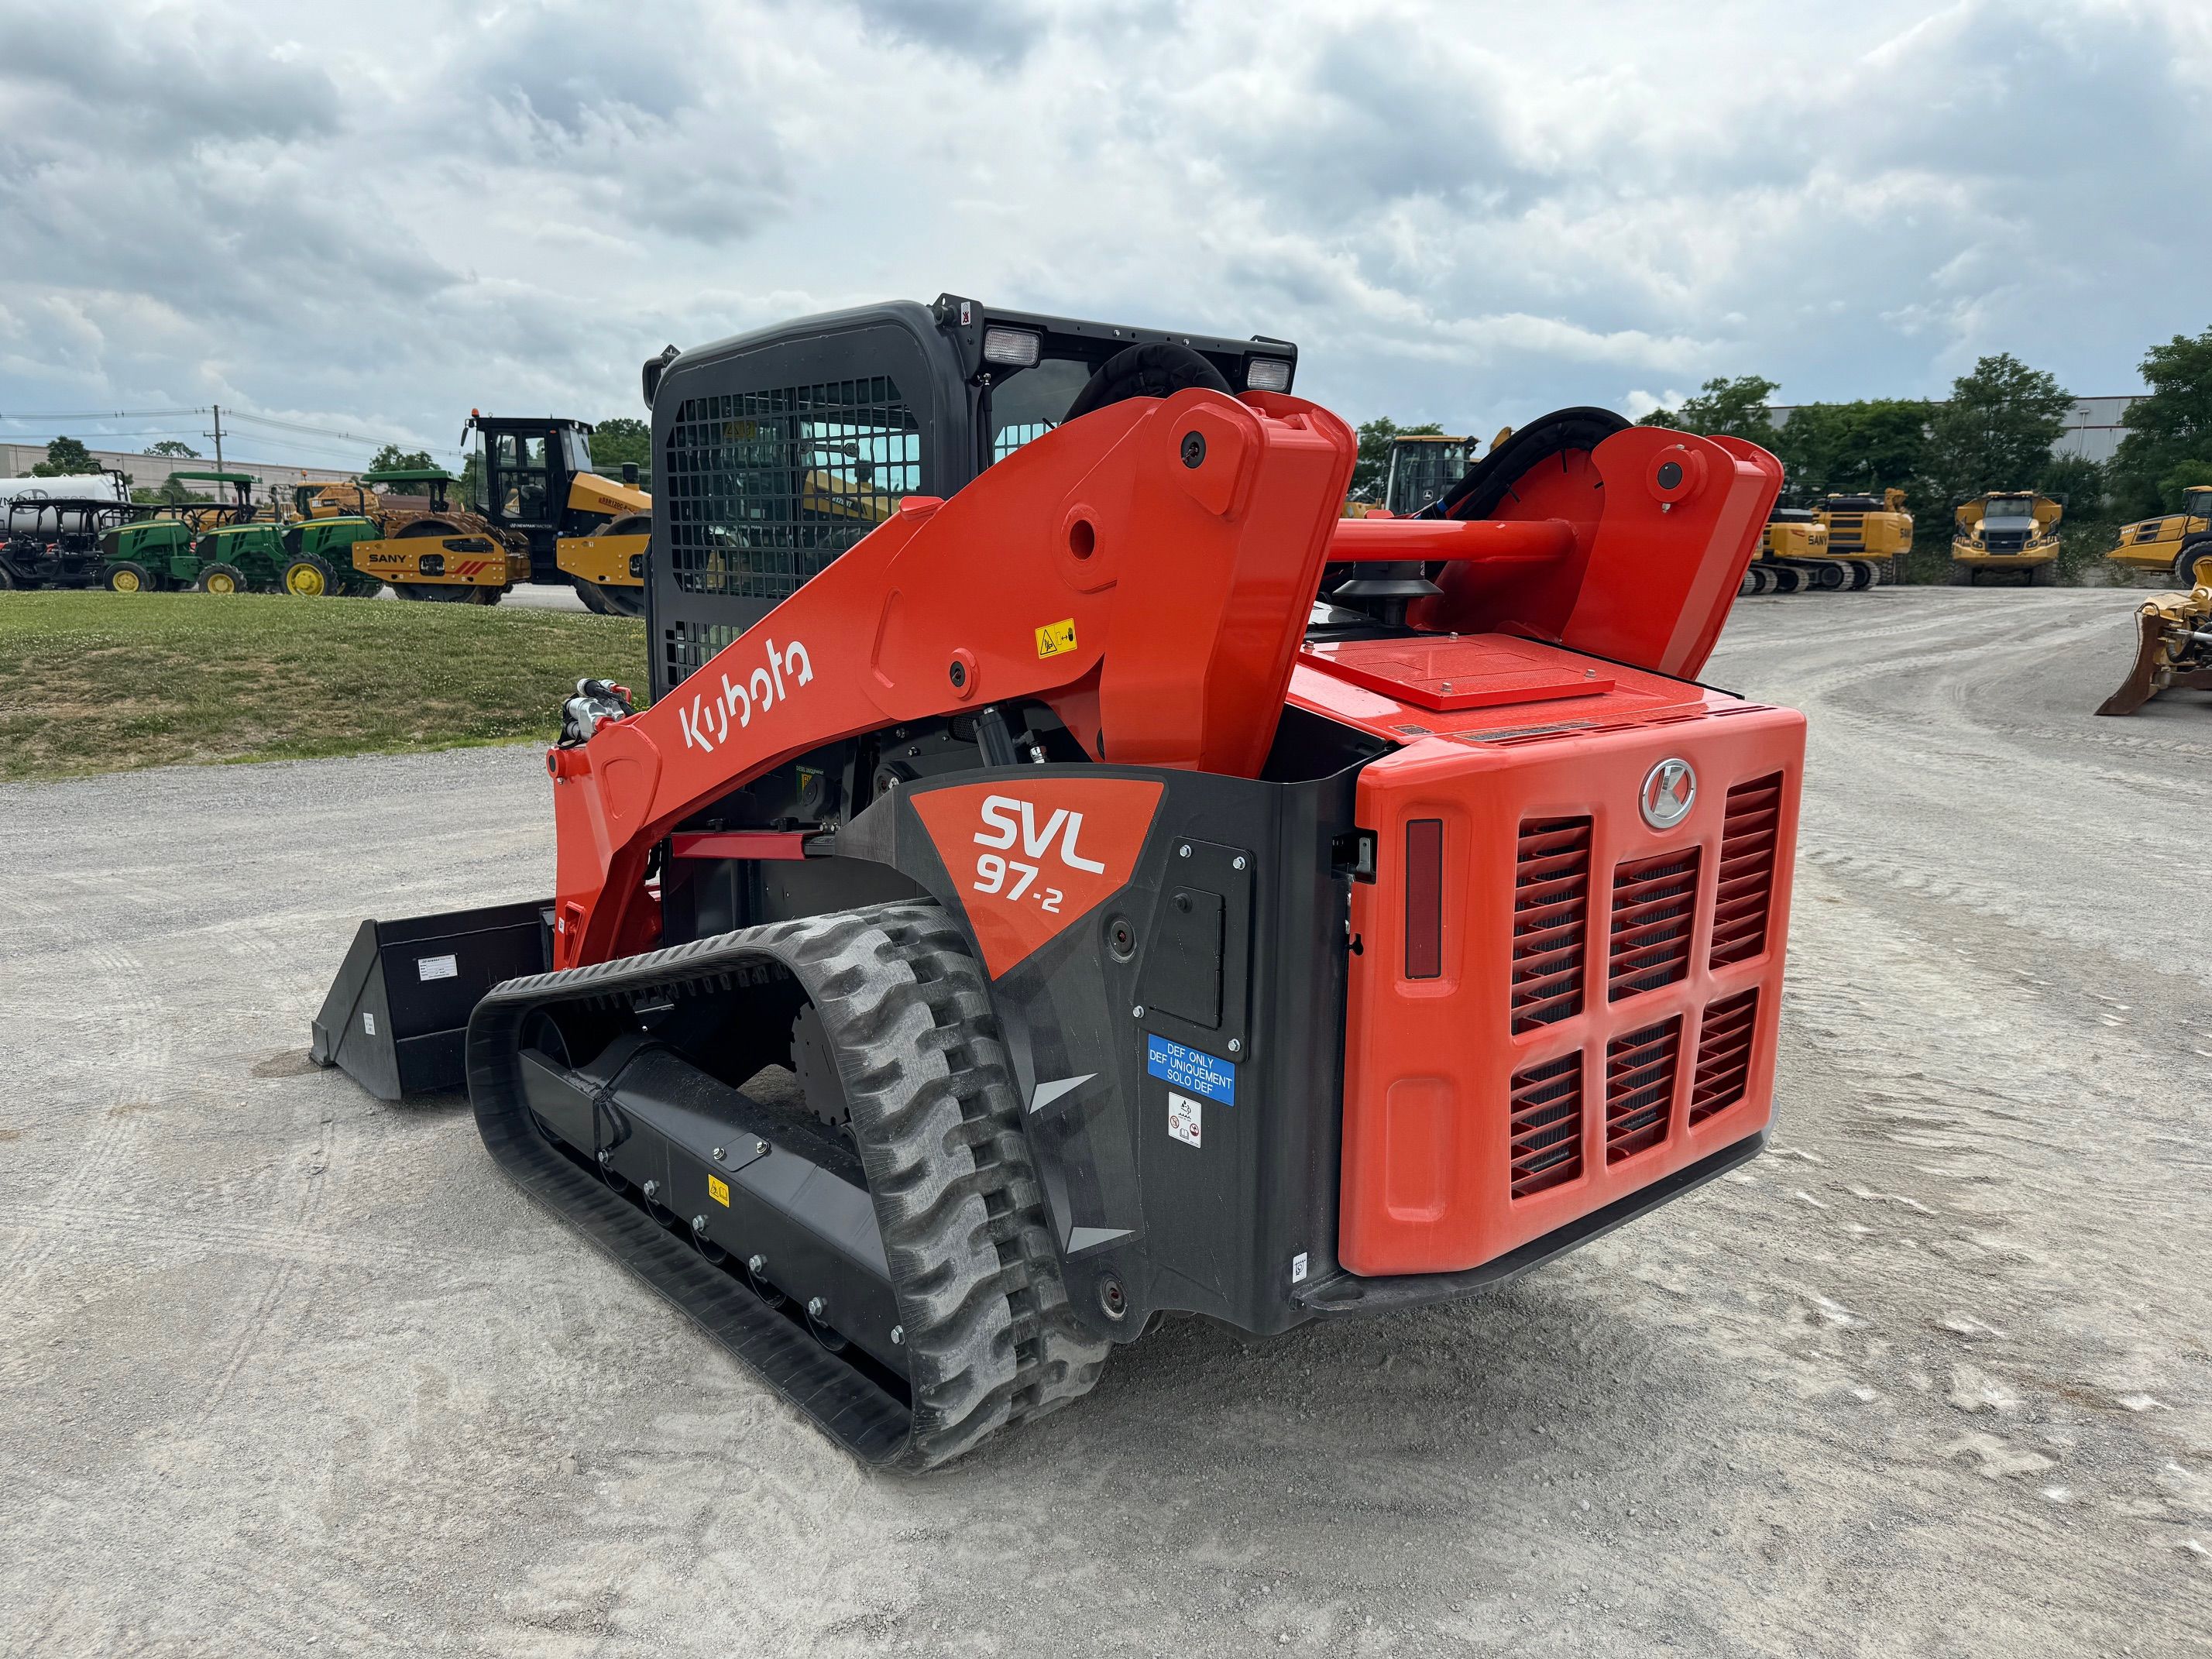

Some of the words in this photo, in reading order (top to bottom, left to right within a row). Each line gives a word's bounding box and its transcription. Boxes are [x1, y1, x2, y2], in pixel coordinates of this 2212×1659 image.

[1808, 534, 1828, 545] SANY
[369, 554, 407, 563] SANY
[678, 638, 814, 753] Kubota
[973, 795, 1105, 875] SVL
[973, 854, 1063, 914] 97-2
[1149, 1049, 1168, 1064] DEF
[1170, 1056, 1232, 1090] UNIQUEMENT
[1167, 1042, 1186, 1058] DEF
[1189, 1052, 1214, 1069] ONLY
[1167, 1069, 1191, 1087] SOLO
[1194, 1079, 1214, 1094] DEF
